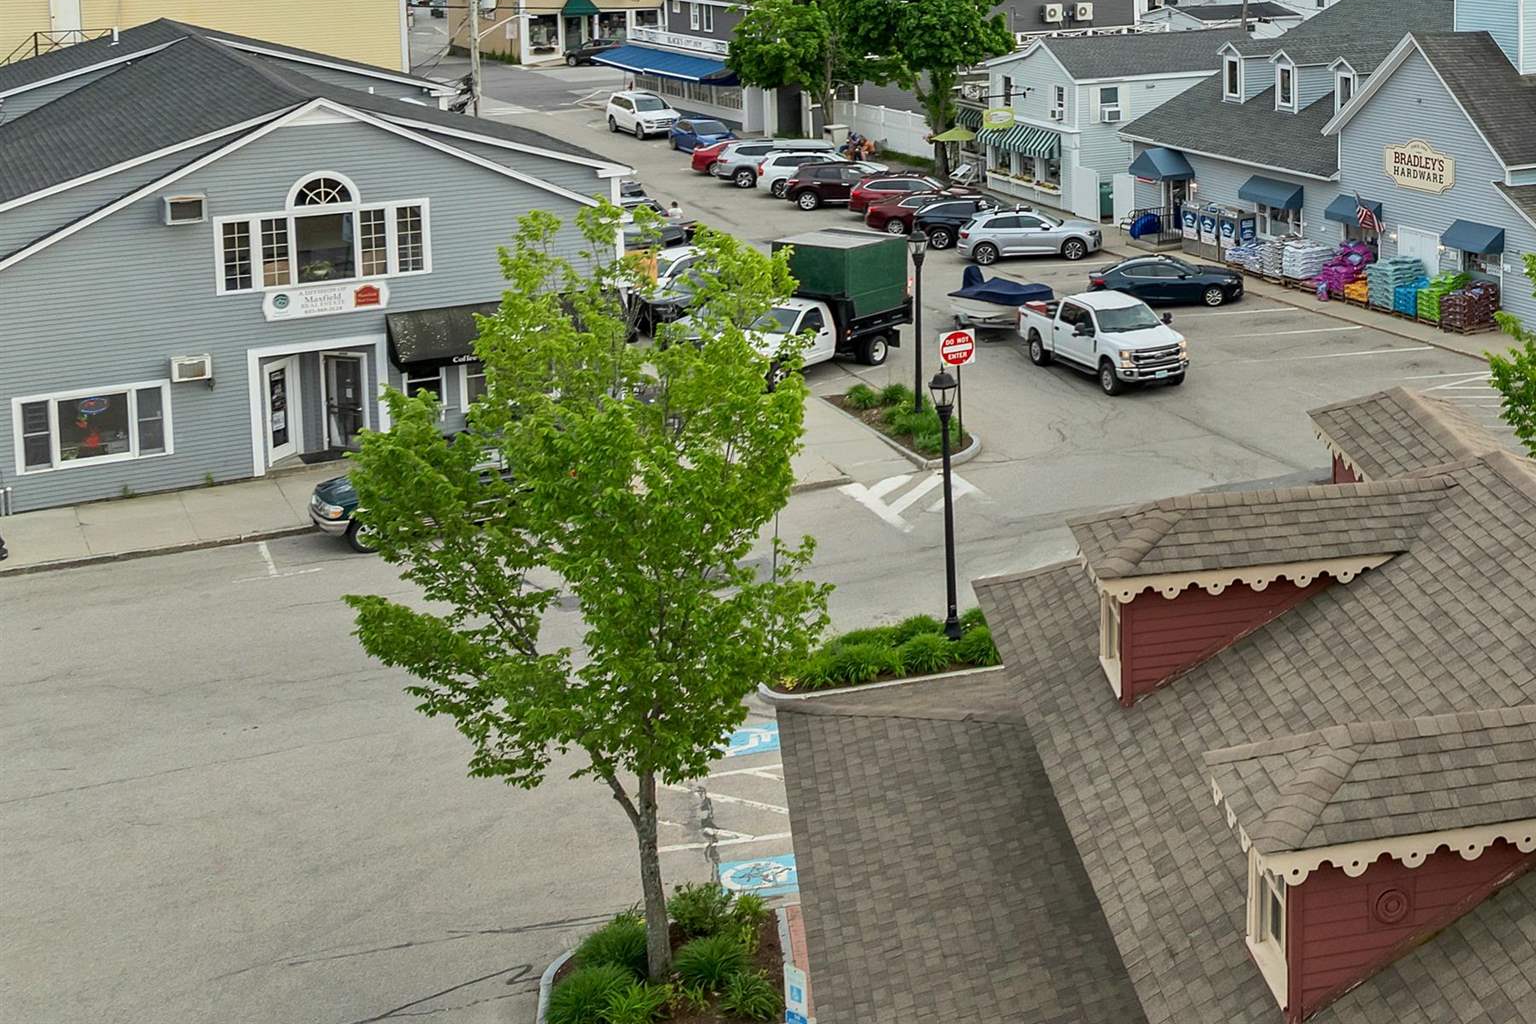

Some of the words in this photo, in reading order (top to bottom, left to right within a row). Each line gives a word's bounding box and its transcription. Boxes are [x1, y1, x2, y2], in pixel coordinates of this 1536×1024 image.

[1393, 151, 1445, 173] BRADLEY'S
[1393, 165, 1444, 184] HARDWARE
[304, 293, 342, 303] Maxfield
[945, 338, 955, 346] DO
[956, 336, 969, 344] NOT
[948, 351, 968, 361] ENTER
